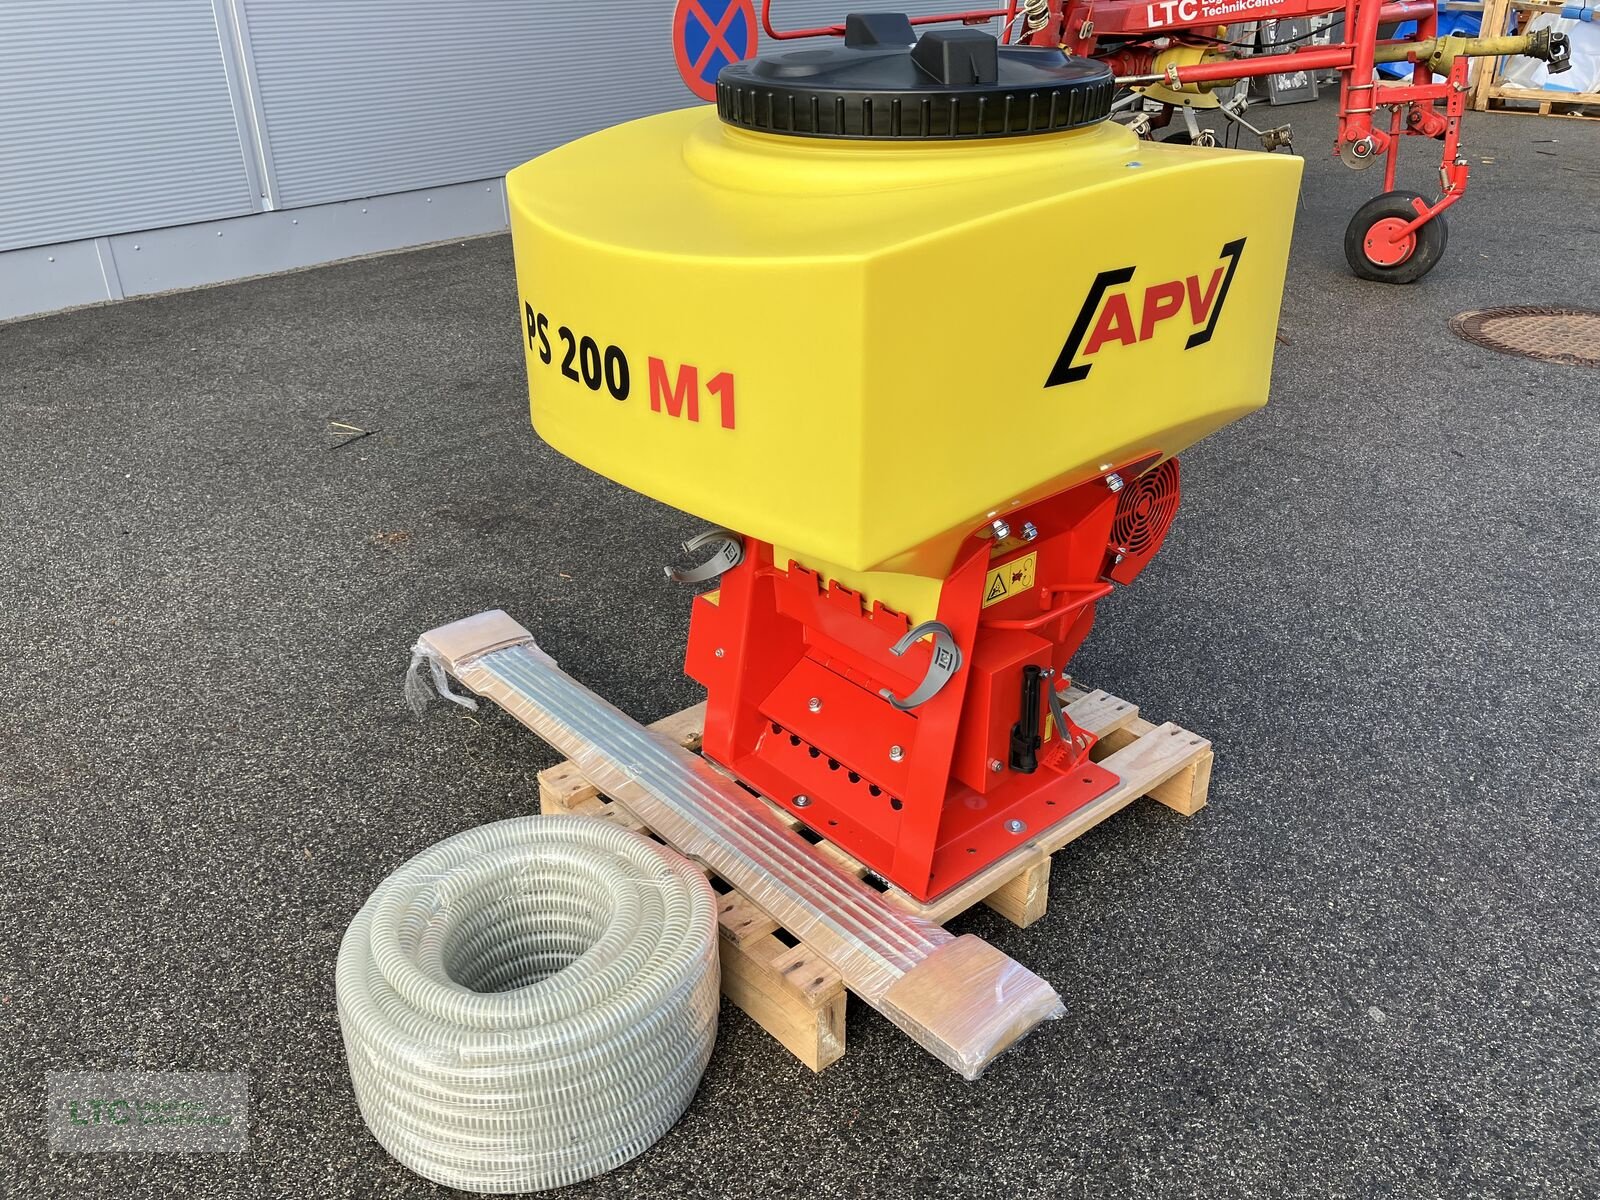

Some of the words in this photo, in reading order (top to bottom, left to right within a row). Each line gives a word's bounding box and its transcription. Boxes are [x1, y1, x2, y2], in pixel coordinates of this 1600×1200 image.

[1147, 0, 1197, 28] LTC
[525, 300, 551, 365] PS
[558, 326, 630, 401] 200
[648, 356, 735, 430] M1
